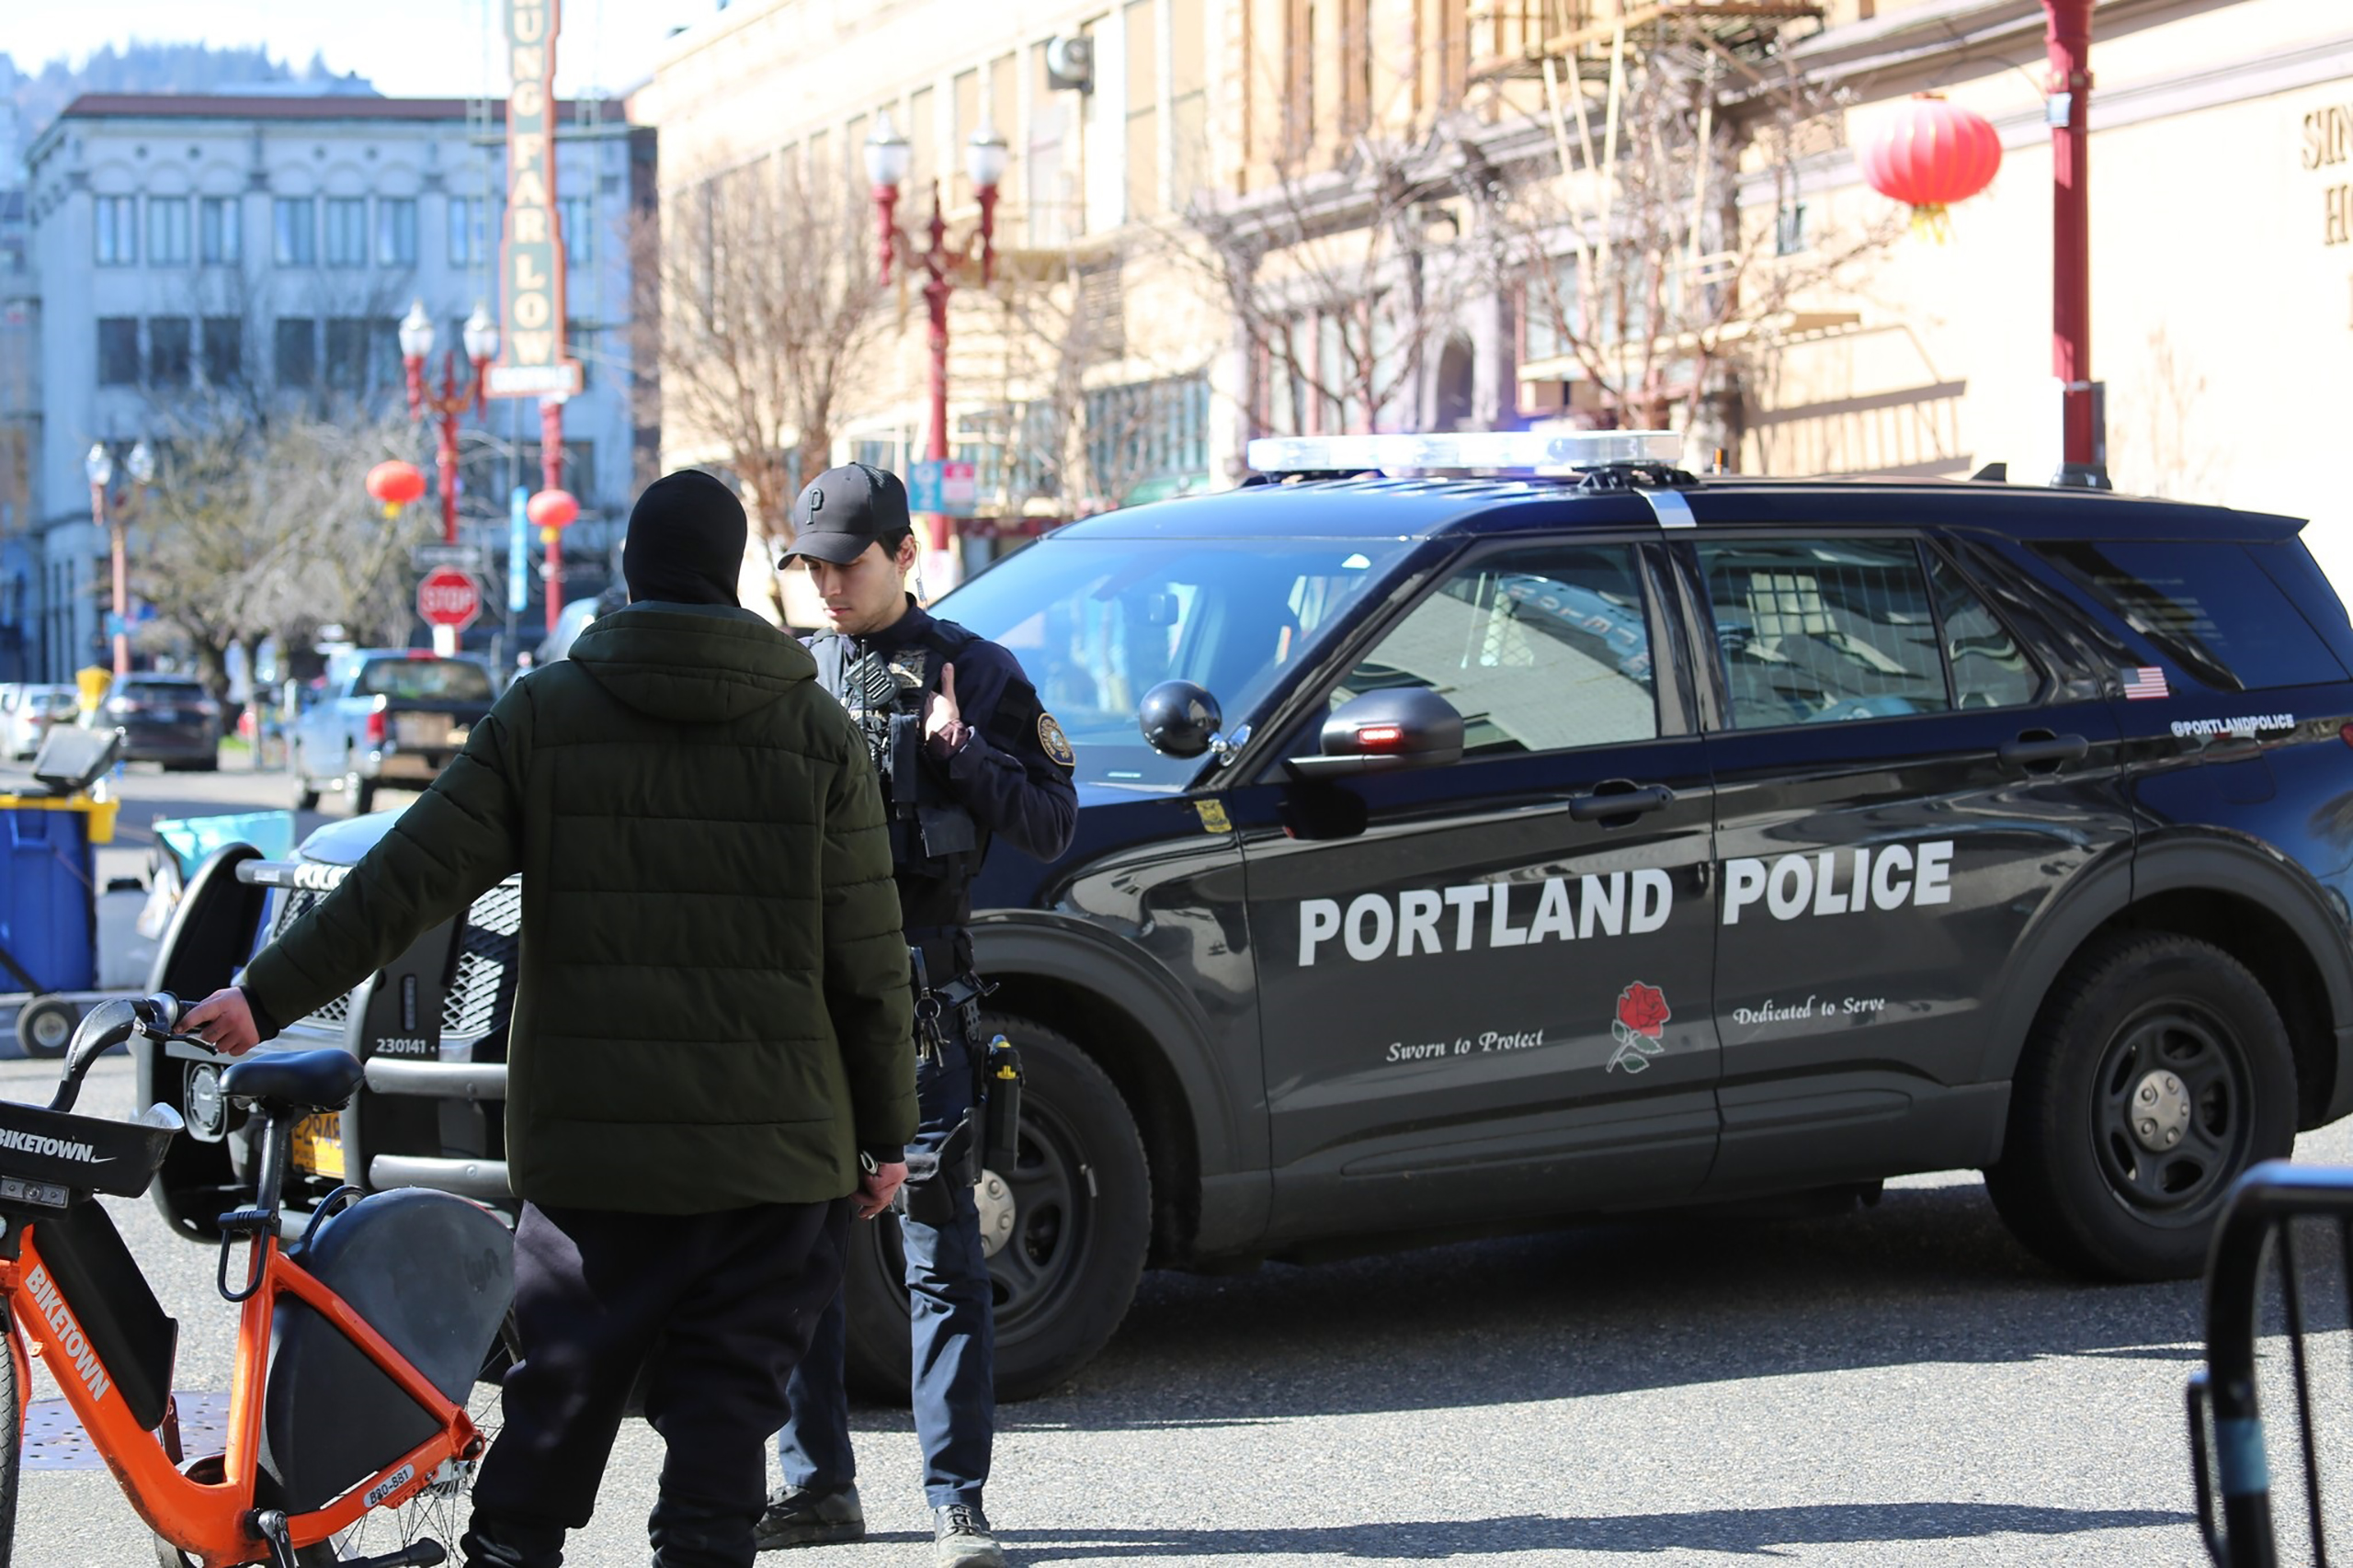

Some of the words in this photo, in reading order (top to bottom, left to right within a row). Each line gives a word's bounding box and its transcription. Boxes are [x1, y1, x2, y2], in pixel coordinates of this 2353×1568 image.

[512, 0, 544, 118] UNG
[510, 133, 549, 244] FAR
[2325, 185, 2353, 245] H
[513, 254, 551, 365] LOW
[806, 488, 824, 525] P
[423, 585, 474, 614] STOP
[2170, 713, 2295, 737] @PORTLANDPOLICE
[1298, 868, 1673, 966] PORTLAND
[1722, 840, 1955, 925] POLICE
[1733, 994, 1816, 1025] Dedicated
[1821, 1001, 1836, 1017] to
[1842, 996, 1885, 1014] Serve
[376, 1038, 426, 1053] 230141
[1386, 1041, 1446, 1062] Sworn
[1454, 1038, 1471, 1054] to
[1478, 1028, 1544, 1052] Protect
[462, 1247, 503, 1294] lyft
[25, 1263, 110, 1402] BIKETOWN
